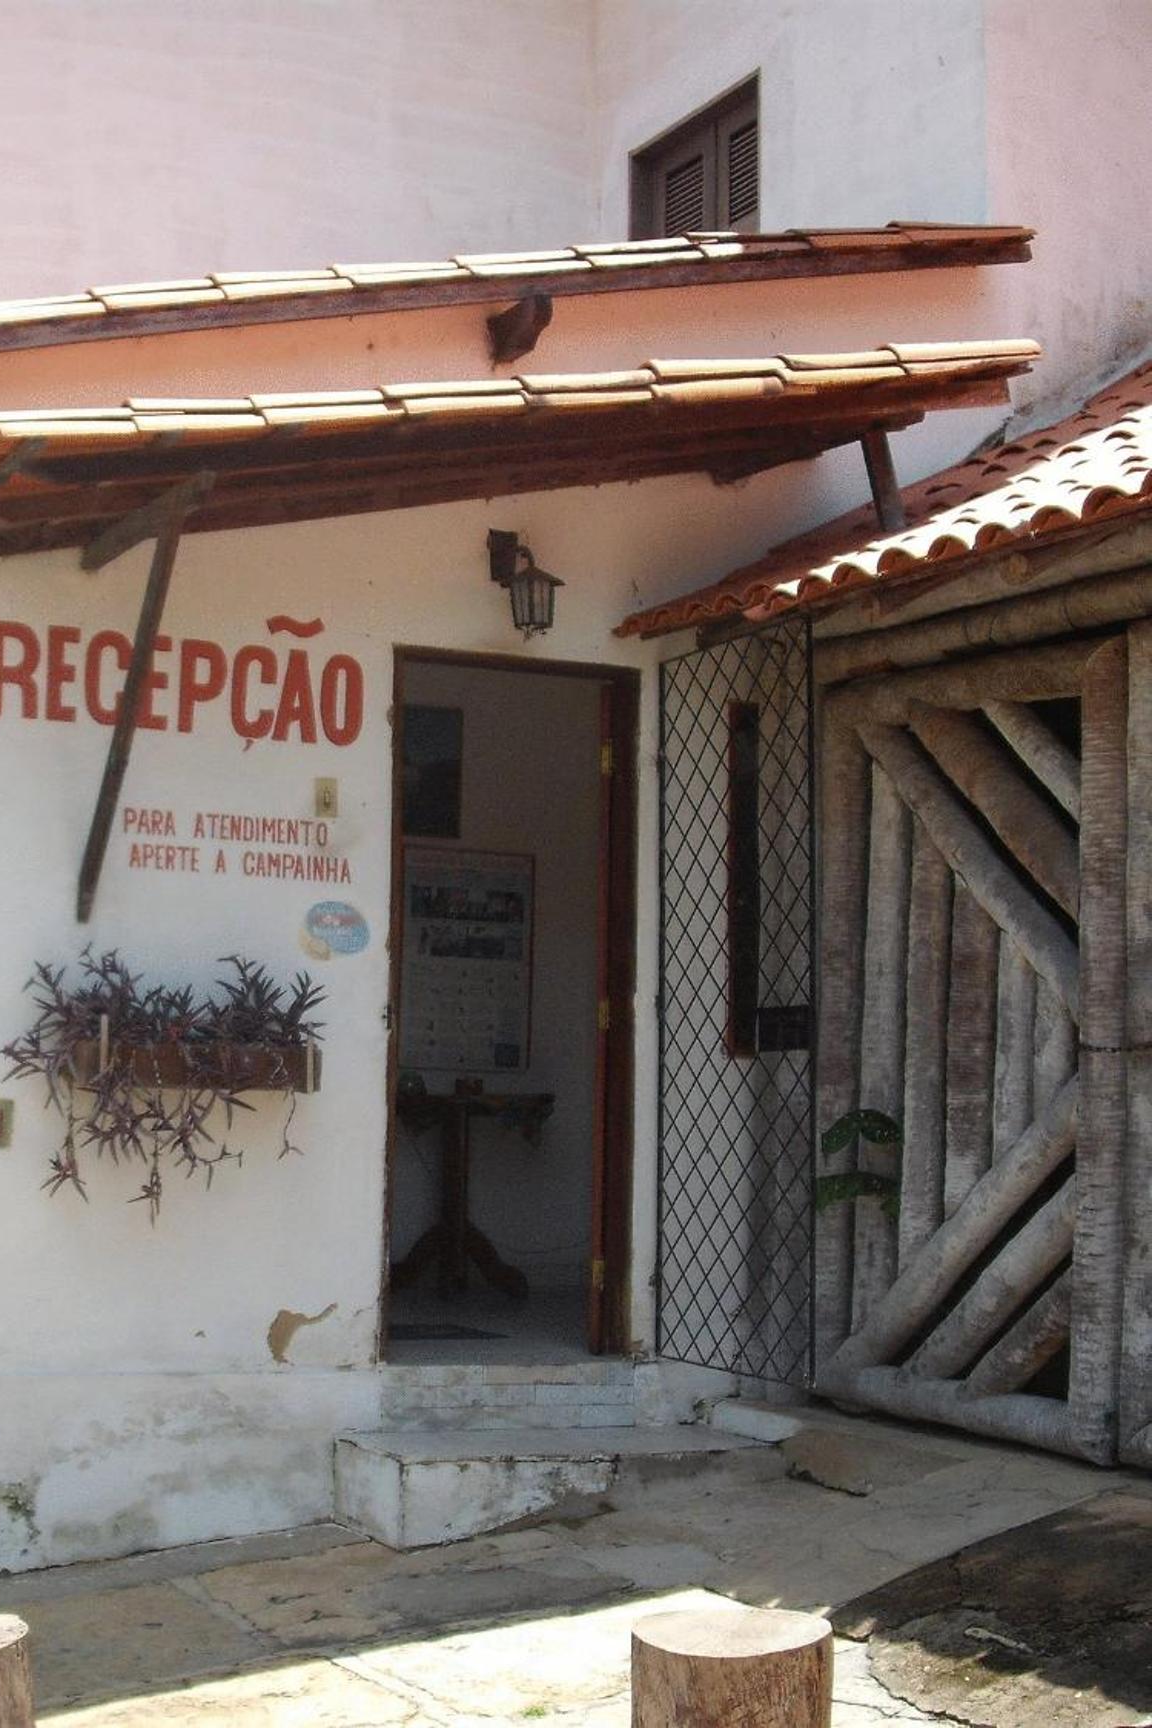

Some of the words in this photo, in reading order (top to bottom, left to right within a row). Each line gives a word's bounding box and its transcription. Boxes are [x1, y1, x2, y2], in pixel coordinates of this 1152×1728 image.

[123, 808, 176, 836] PARA
[193, 813, 328, 847] ATENDIMENTO
[129, 843, 200, 873] APERTE
[215, 850, 226, 874] A
[243, 851, 351, 884] CAMPAINHA
